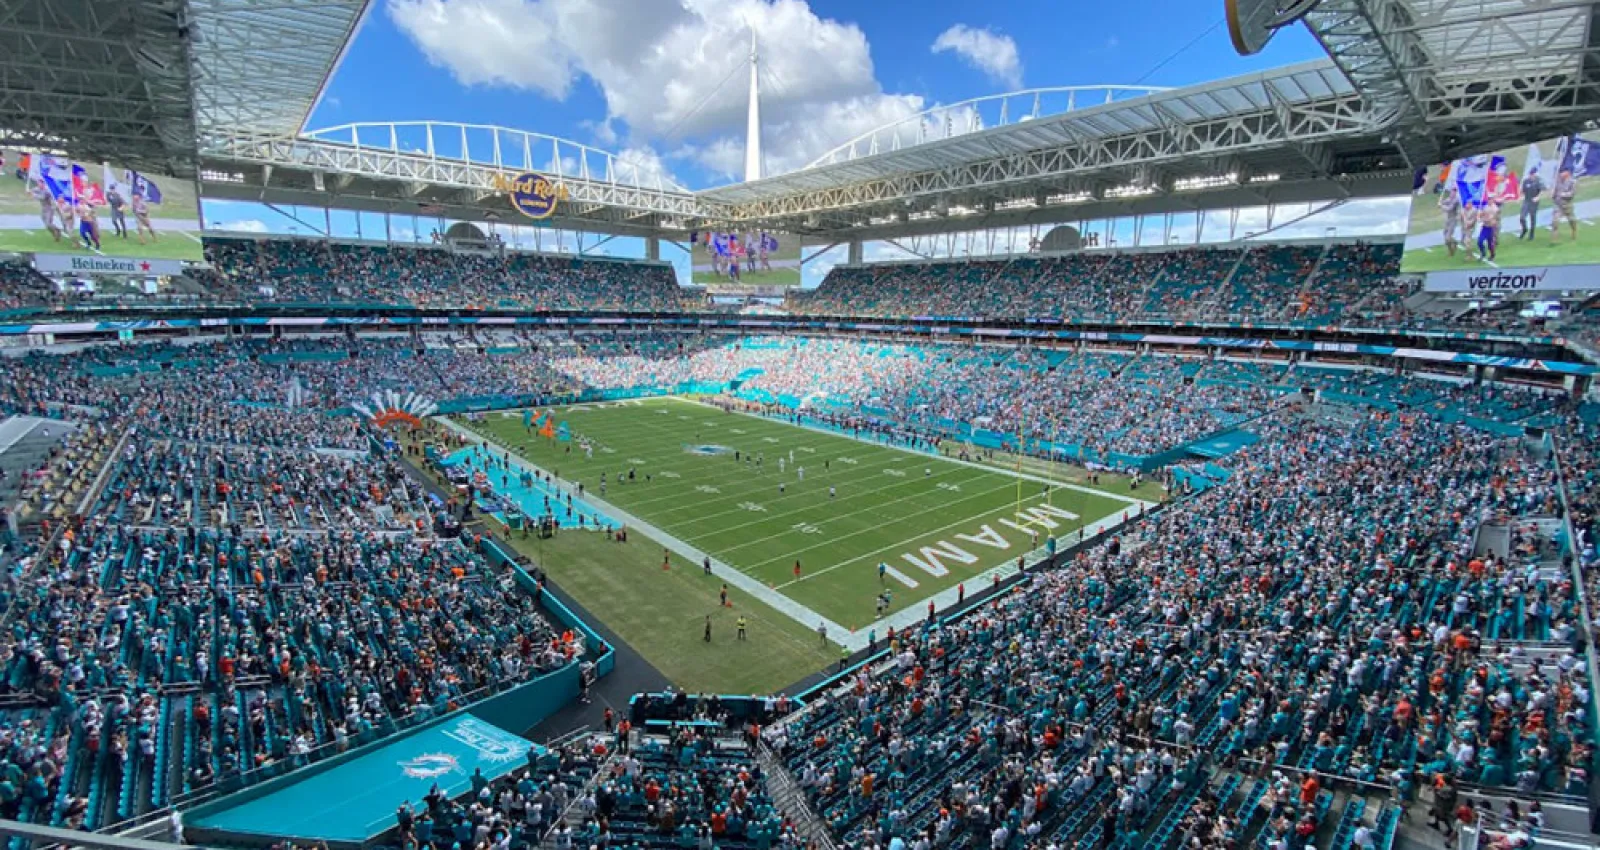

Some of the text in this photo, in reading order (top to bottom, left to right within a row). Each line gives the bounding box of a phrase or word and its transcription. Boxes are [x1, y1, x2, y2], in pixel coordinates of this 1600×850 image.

[71, 257, 135, 271] Heineken
[1468, 271, 1537, 288] verizon
[878, 502, 1080, 588] MIAMI
